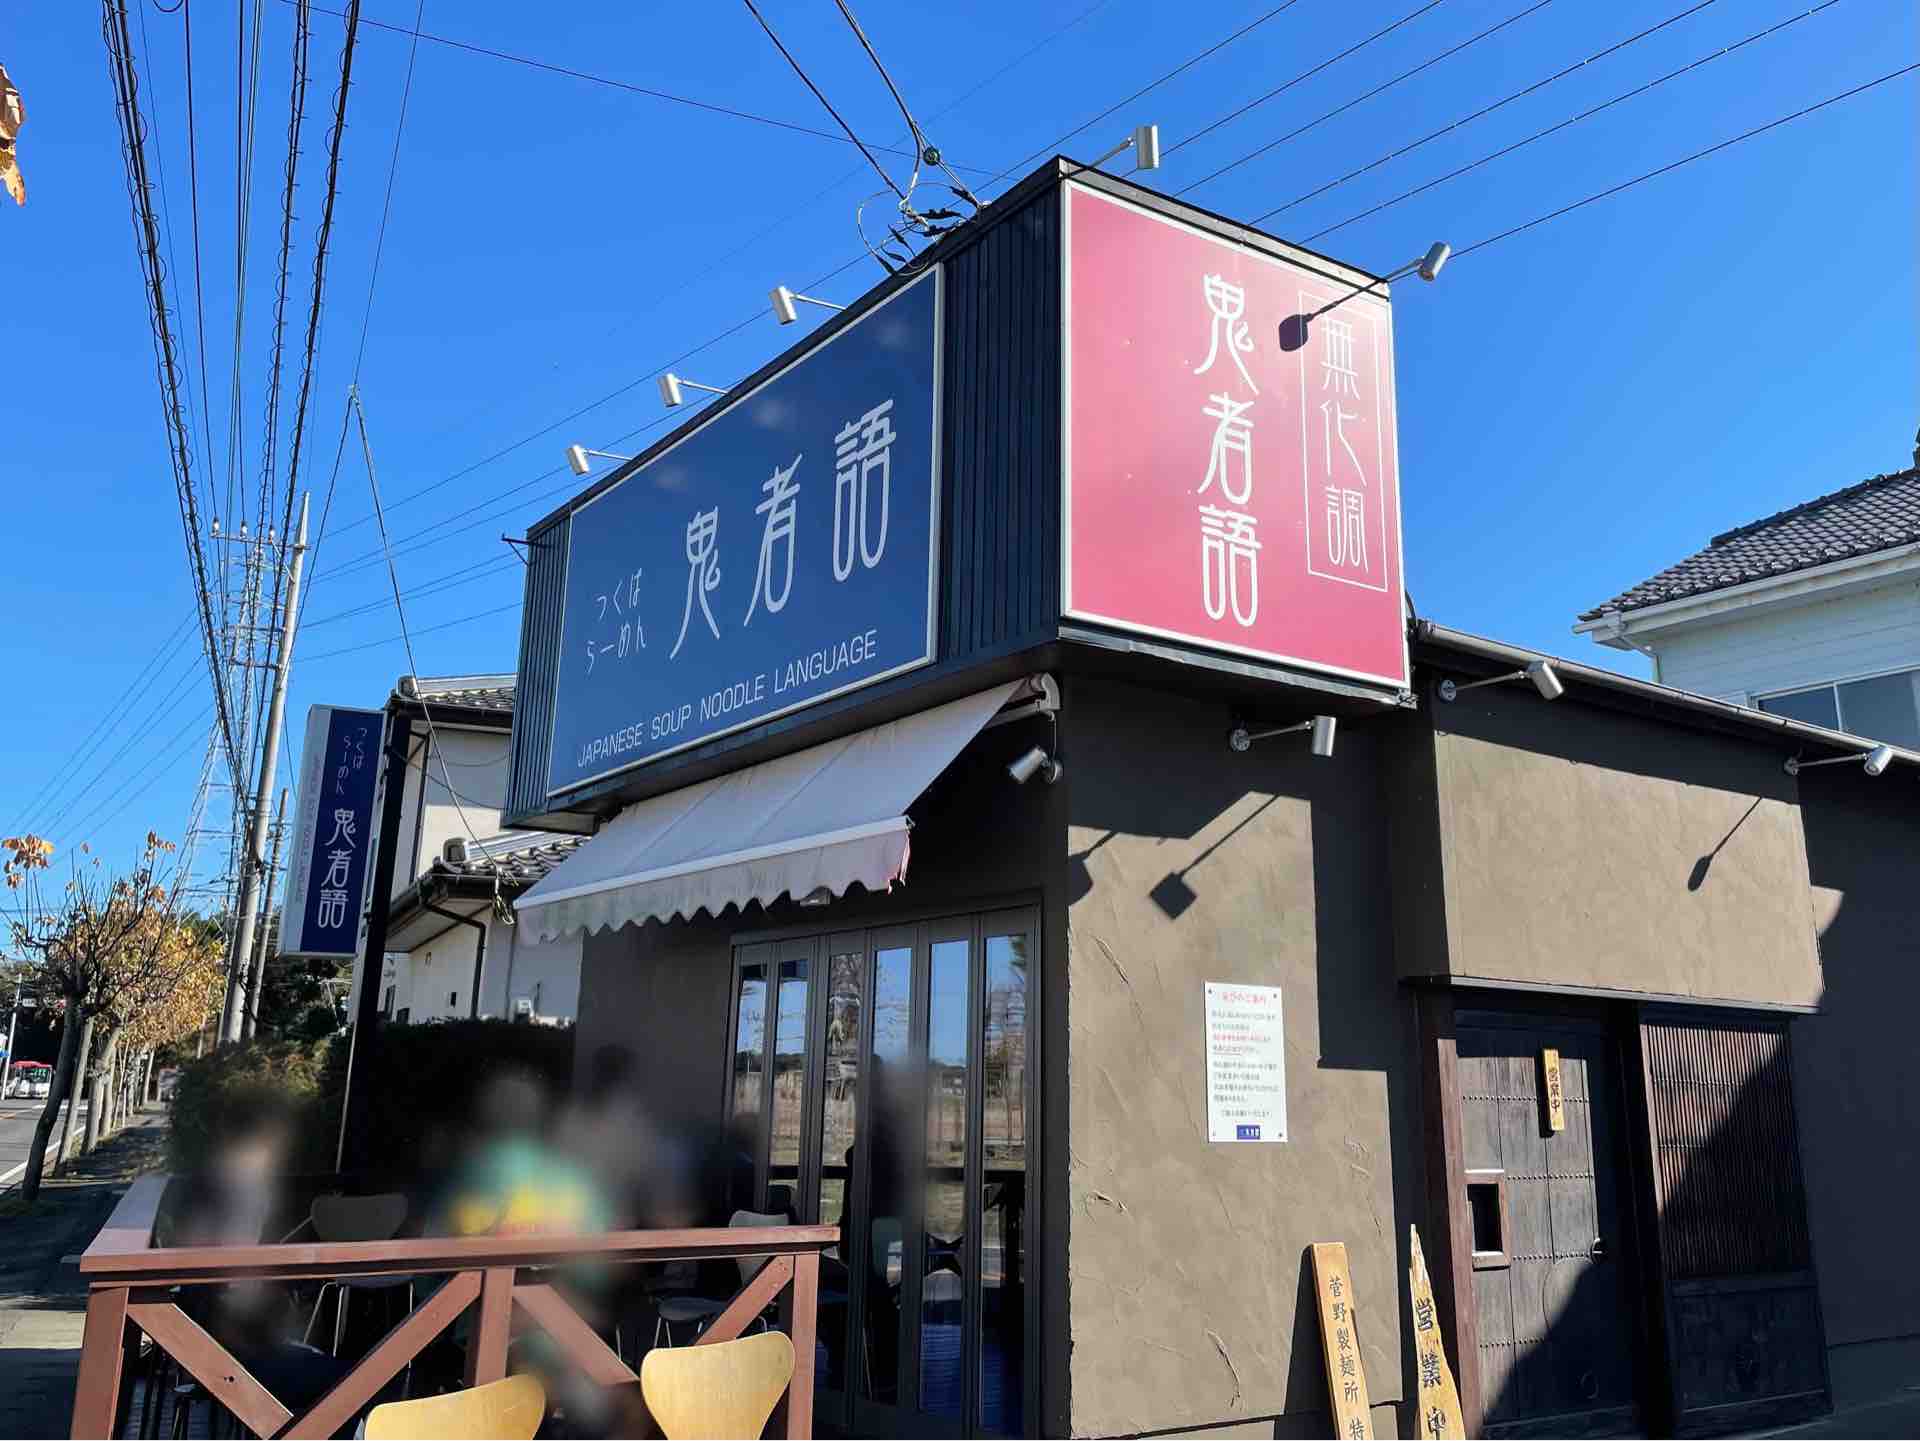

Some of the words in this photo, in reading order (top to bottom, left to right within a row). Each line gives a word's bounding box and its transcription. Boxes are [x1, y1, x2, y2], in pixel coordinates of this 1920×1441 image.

[1194, 273, 1262, 627] 鬼者語
[1320, 316, 1369, 573] 無化調
[596, 567, 642, 620] つくば
[669, 399, 896, 660] 鬼者語
[577, 723, 643, 768] JAPANESE
[651, 704, 692, 741] SOUP
[700, 674, 766, 723] NOODLE
[774, 629, 877, 694] LANGUAGE
[586, 615, 647, 674] らーめん
[317, 808, 357, 929] 鬼者語
